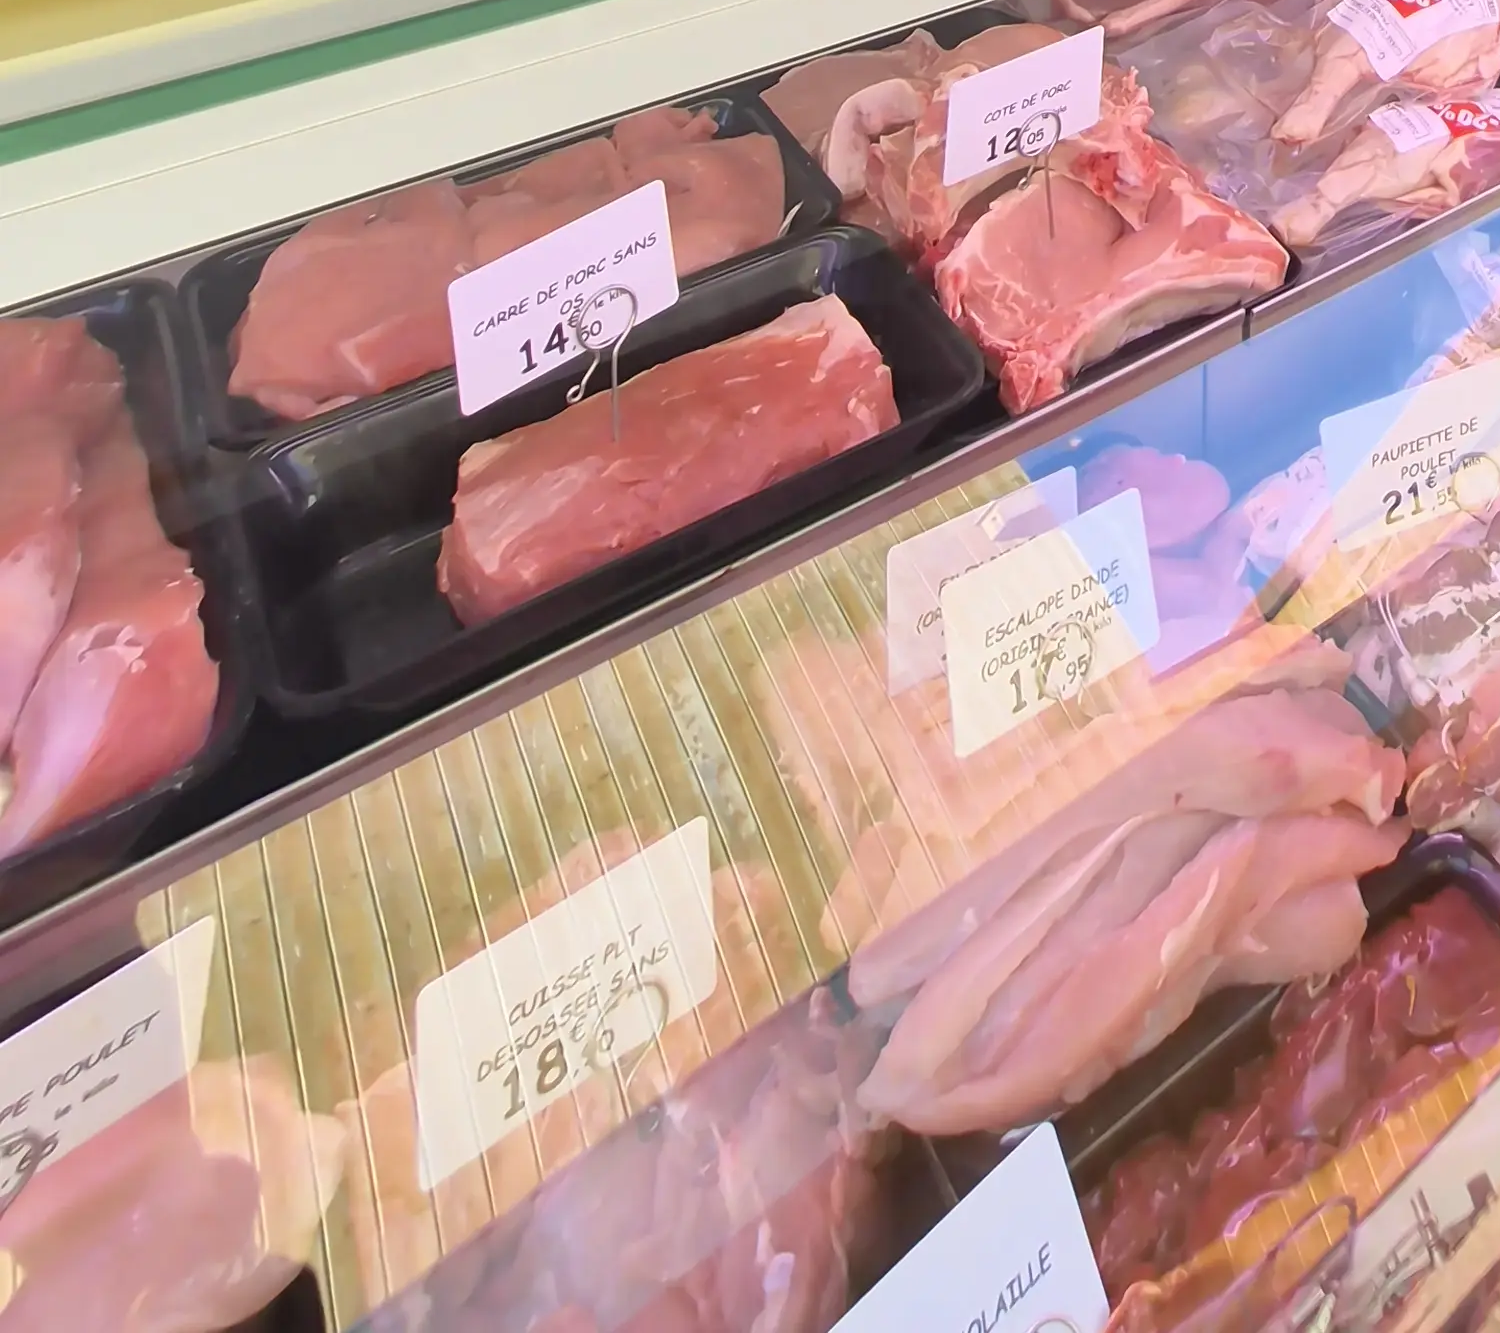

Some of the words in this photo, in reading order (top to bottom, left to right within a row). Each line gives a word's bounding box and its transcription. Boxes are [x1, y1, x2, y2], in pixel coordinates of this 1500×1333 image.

[983, 101, 1018, 124] COTE
[1021, 93, 1038, 110] DE
[1041, 79, 1072, 101] PORC
[473, 297, 530, 337] CARRE
[536, 282, 559, 306] DE
[565, 258, 607, 290] PORC
[612, 232, 657, 265] SANS
[559, 293, 585, 316] OS
[1371, 425, 1453, 468] PAUPIETTE
[1459, 416, 1478, 436] DE
[1400, 448, 1457, 480] POULET
[984, 589, 1065, 649] ESCALOPE
[1071, 559, 1121, 601] DINDE
[476, 983, 602, 1083] DESOSSEE
[609, 939, 670, 994] SANS
[508, 953, 596, 1027] CUISSE
[43, 1009, 162, 1098] POULET
[961, 1241, 1053, 1333] OLAILLE
